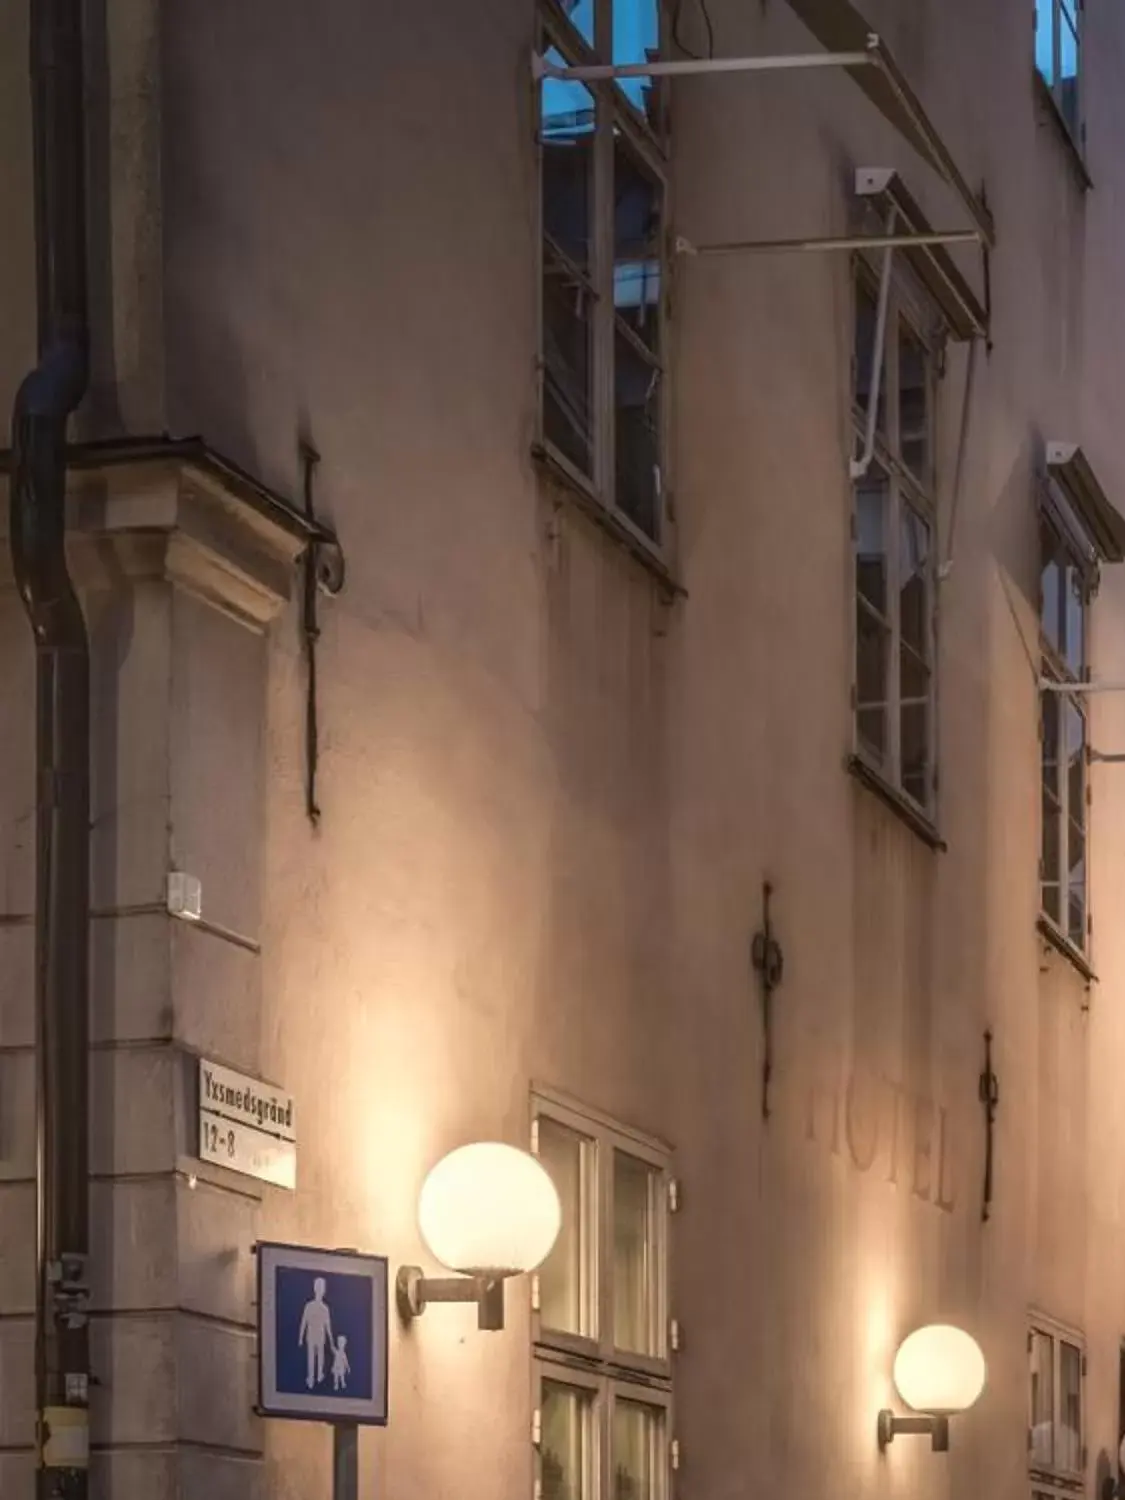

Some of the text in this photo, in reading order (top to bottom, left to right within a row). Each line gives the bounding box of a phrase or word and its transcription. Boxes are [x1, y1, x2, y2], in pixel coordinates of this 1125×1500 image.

[204, 1070, 292, 1127] Yxsmedsgränd
[202, 1121, 236, 1159] 12-8
[805, 1071, 954, 1212] HOTEL
